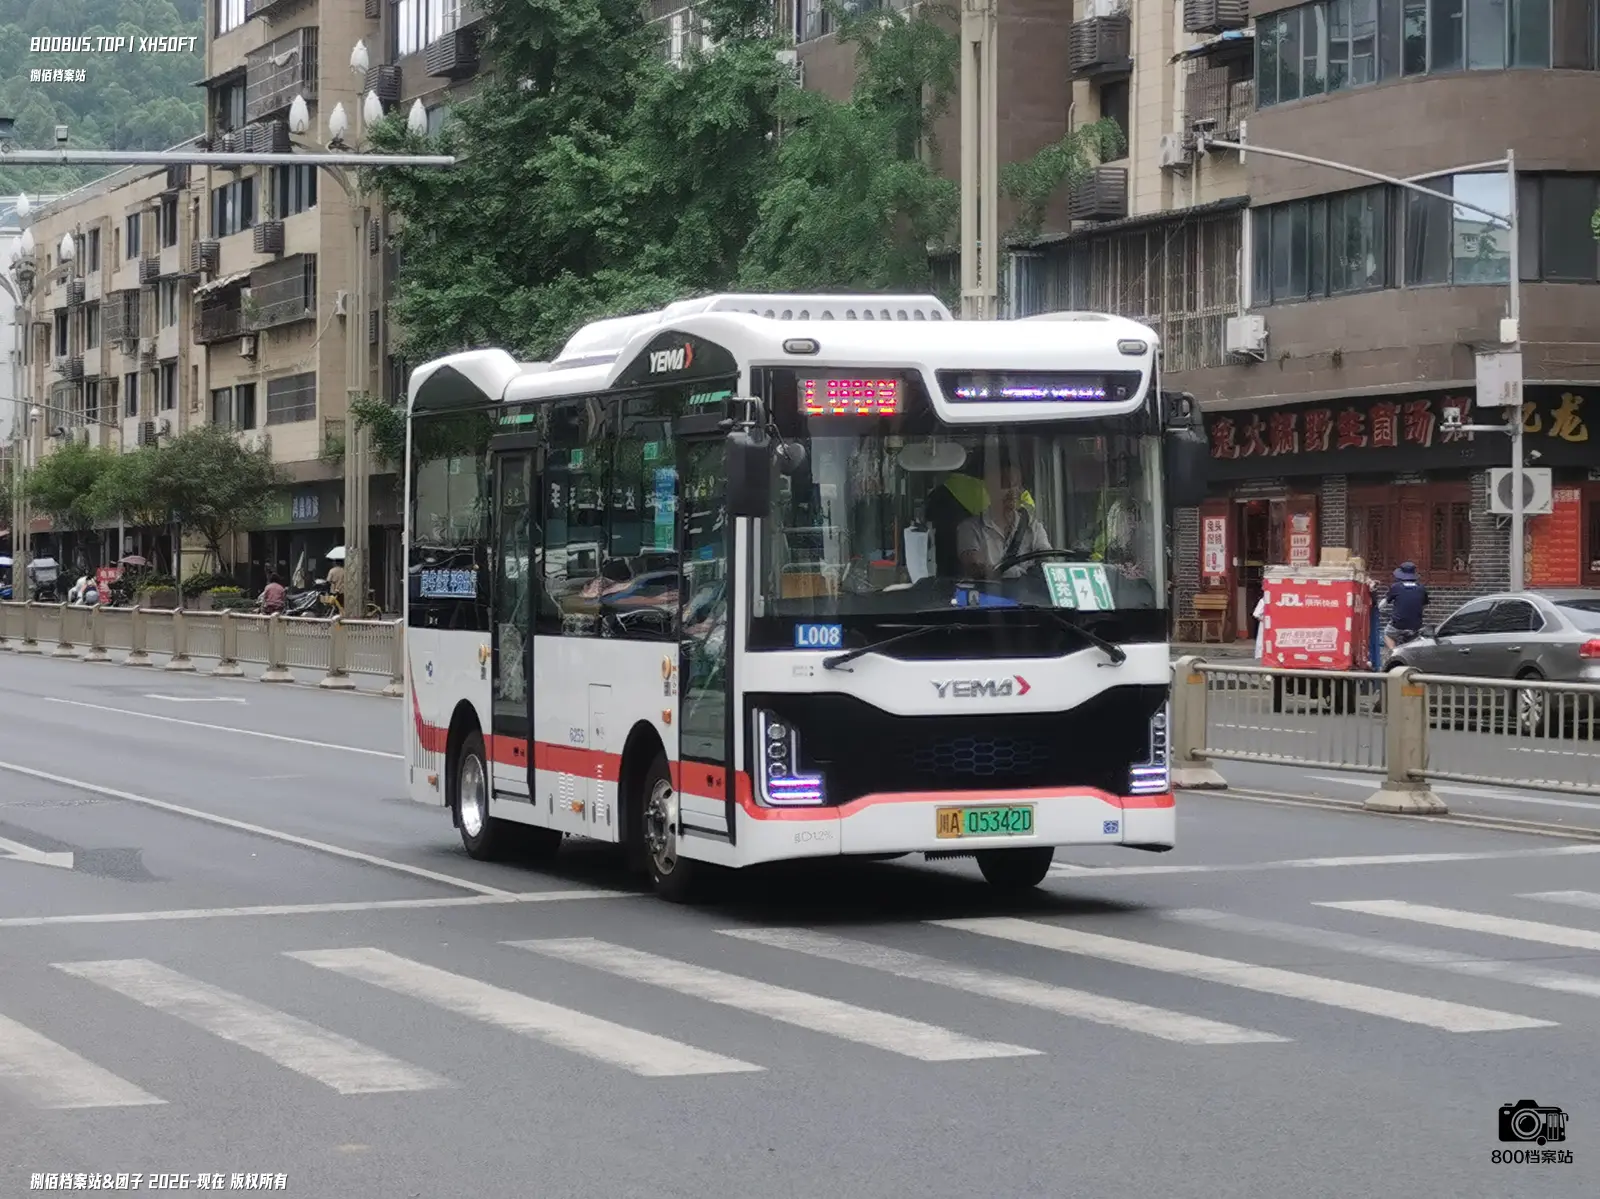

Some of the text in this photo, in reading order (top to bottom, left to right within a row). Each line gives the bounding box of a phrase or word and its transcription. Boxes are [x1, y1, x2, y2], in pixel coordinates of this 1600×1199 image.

[650, 348, 684, 373] YEMA
[1275, 593, 1304, 606] JDL
[798, 625, 840, 645] L008
[930, 678, 1012, 699] YEMA
